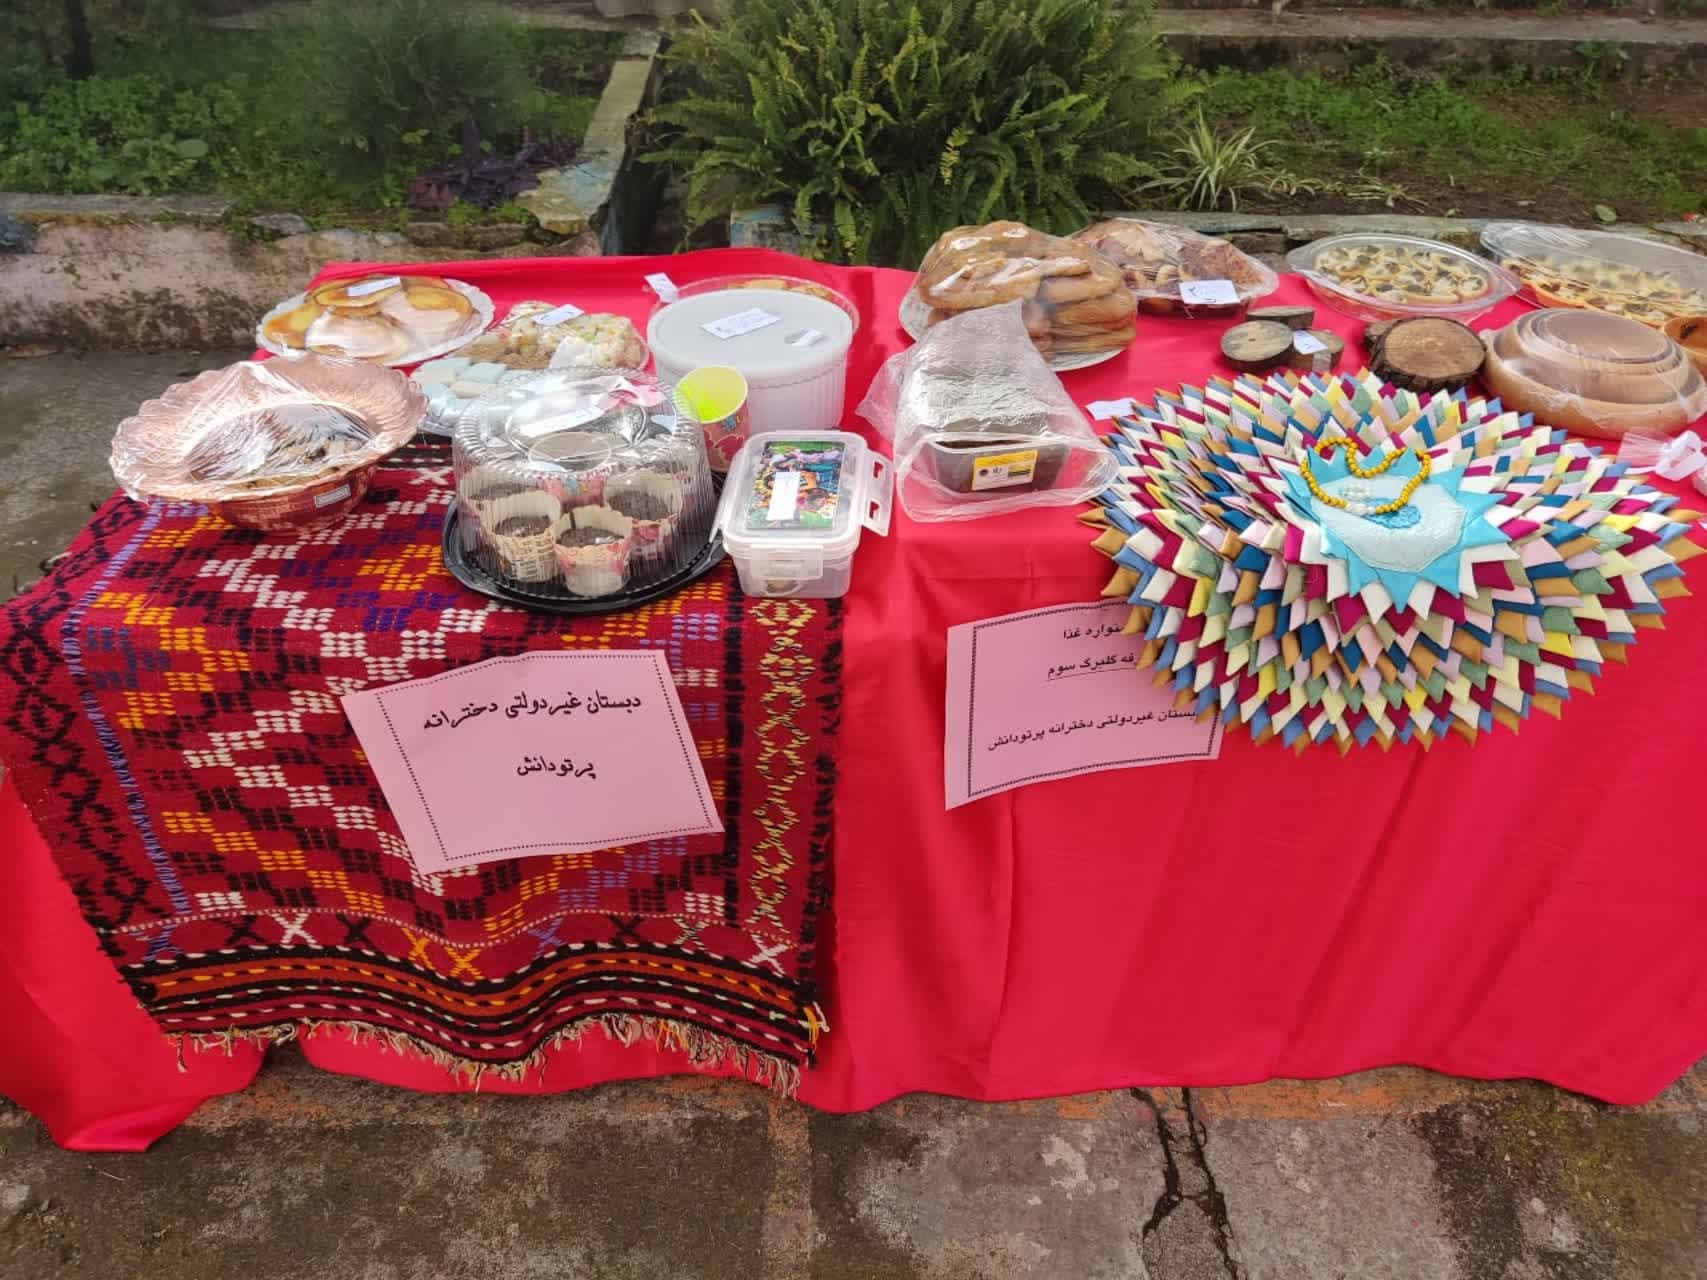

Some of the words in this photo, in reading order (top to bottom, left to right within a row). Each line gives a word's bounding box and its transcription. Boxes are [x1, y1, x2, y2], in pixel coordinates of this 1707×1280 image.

[1063, 626, 1081, 640] غذا
[1085, 623, 1125, 638] نواره
[1047, 663, 1076, 679] سوم
[586, 689, 642, 713] دبستان
[423, 701, 499, 730] دخترانه
[1048, 719, 1093, 735] دخترانه
